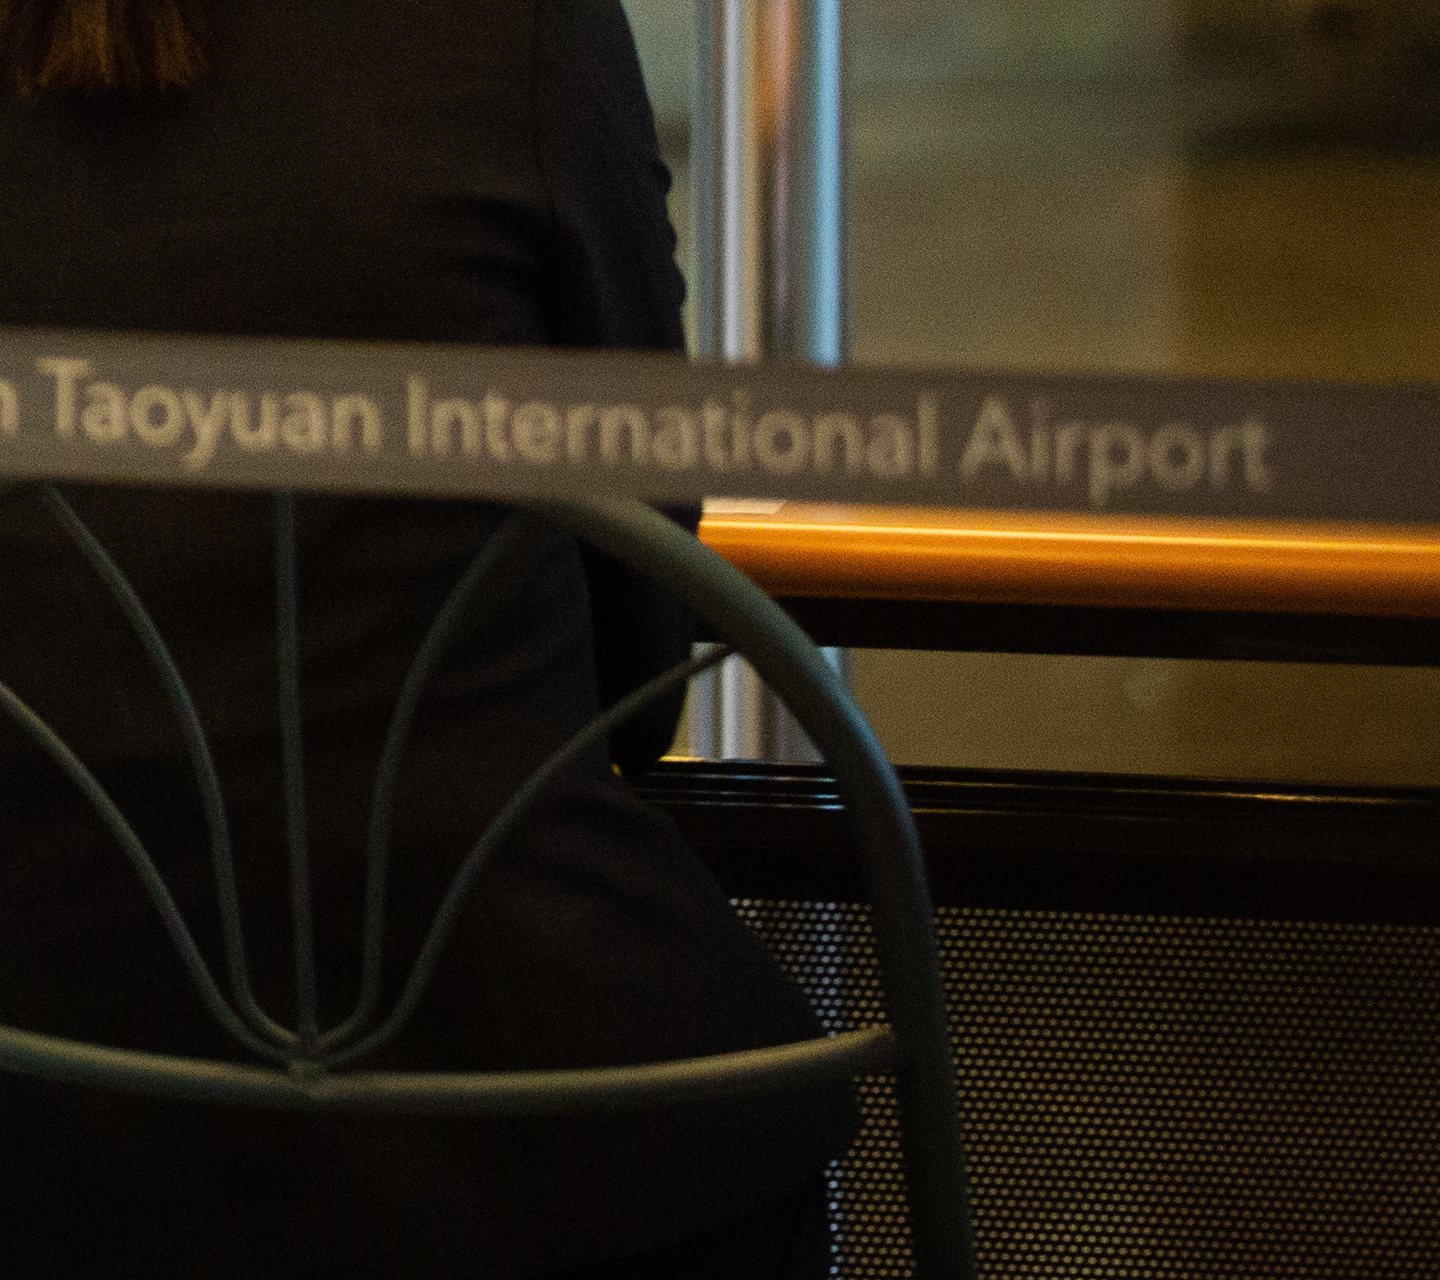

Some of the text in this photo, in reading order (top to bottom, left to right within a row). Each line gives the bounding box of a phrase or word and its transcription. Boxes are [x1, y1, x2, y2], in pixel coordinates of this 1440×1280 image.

[36, 356, 383, 470] Taoyuan
[406, 376, 940, 480] International
[958, 393, 1272, 507] Airport
